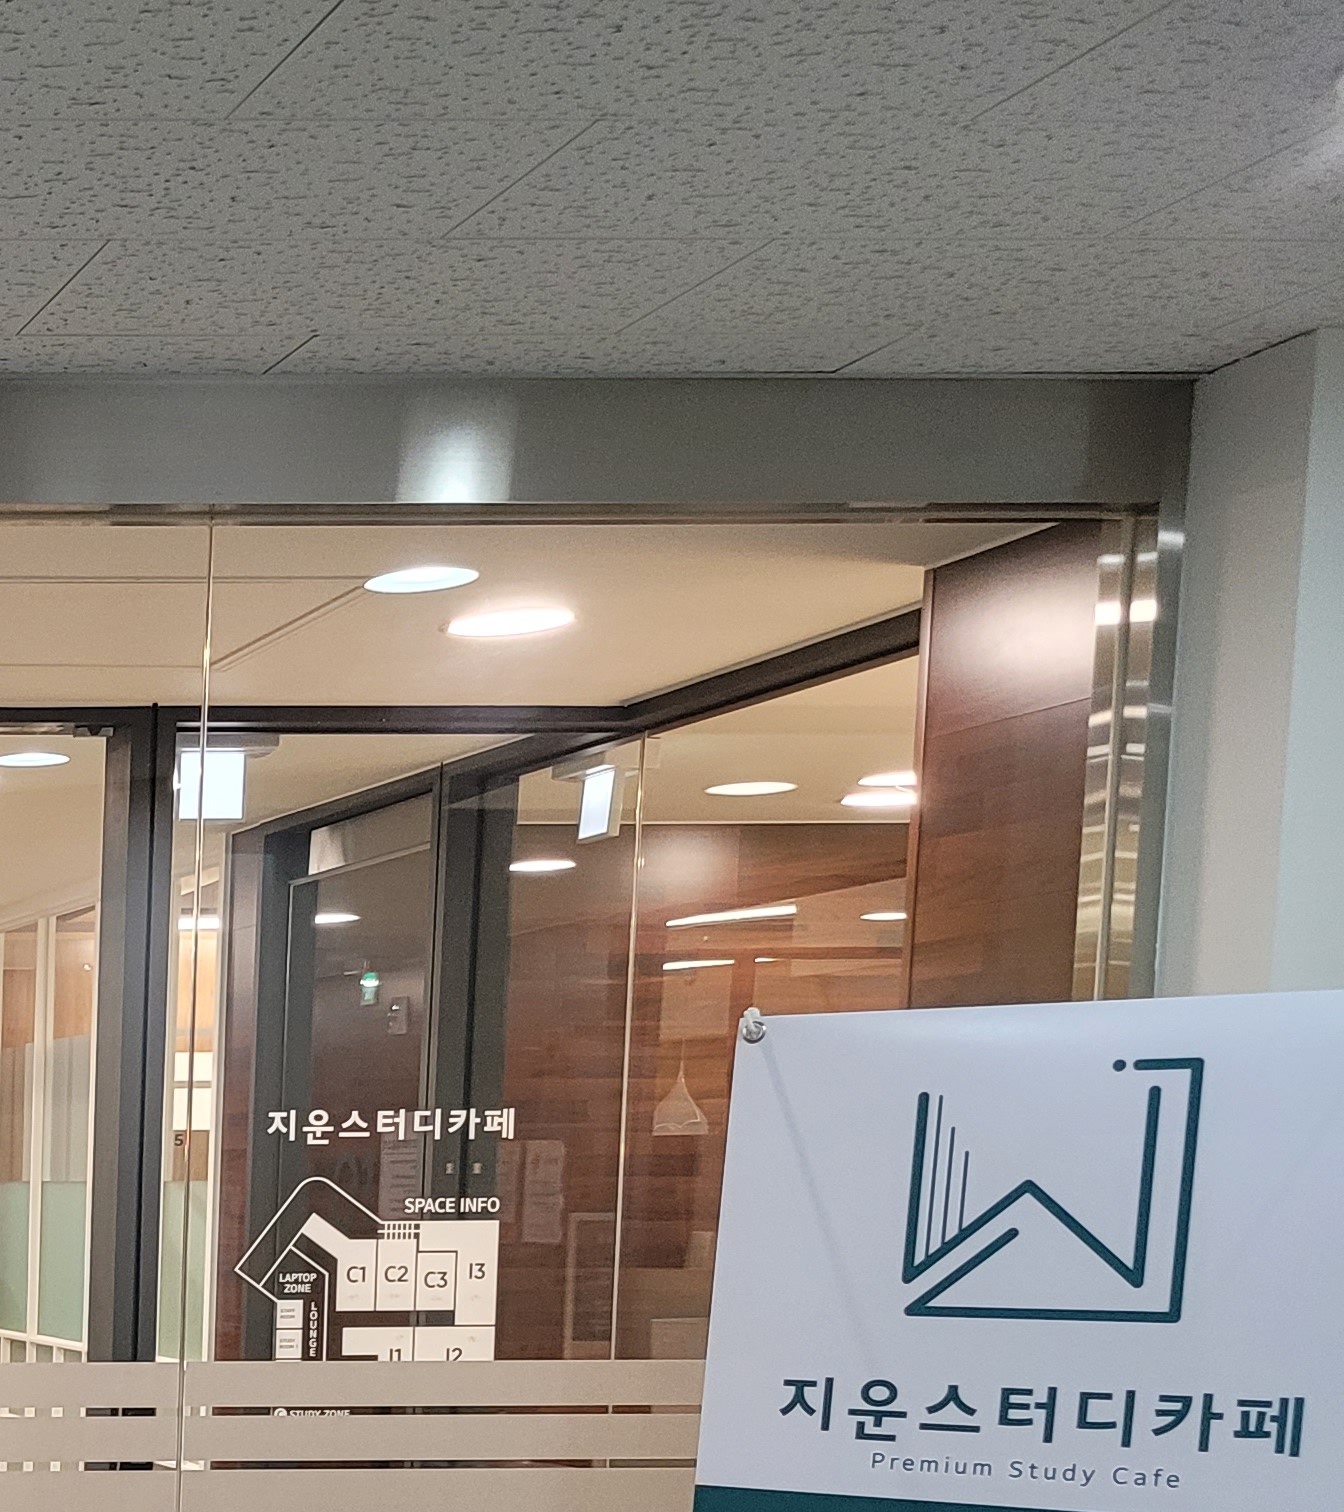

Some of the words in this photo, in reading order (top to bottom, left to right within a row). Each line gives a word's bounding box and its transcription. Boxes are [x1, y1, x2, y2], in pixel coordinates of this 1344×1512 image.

[266, 1107, 516, 1145] 지운스터디카페
[404, 1197, 456, 1213] SPACE
[460, 1197, 500, 1212] INFO
[279, 1272, 317, 1283] LAPTOP
[346, 1266, 367, 1283] C1
[384, 1265, 408, 1283] C2
[424, 1271, 448, 1288] C3
[283, 1284, 312, 1294] ZONE
[309, 1301, 318, 1357] LOUNGE
[779, 1377, 1306, 1457] 지운스터디카페
[871, 1452, 994, 1478] Premium
[1008, 1460, 1097, 1487] Study
[1112, 1465, 1181, 1490] Cafe
